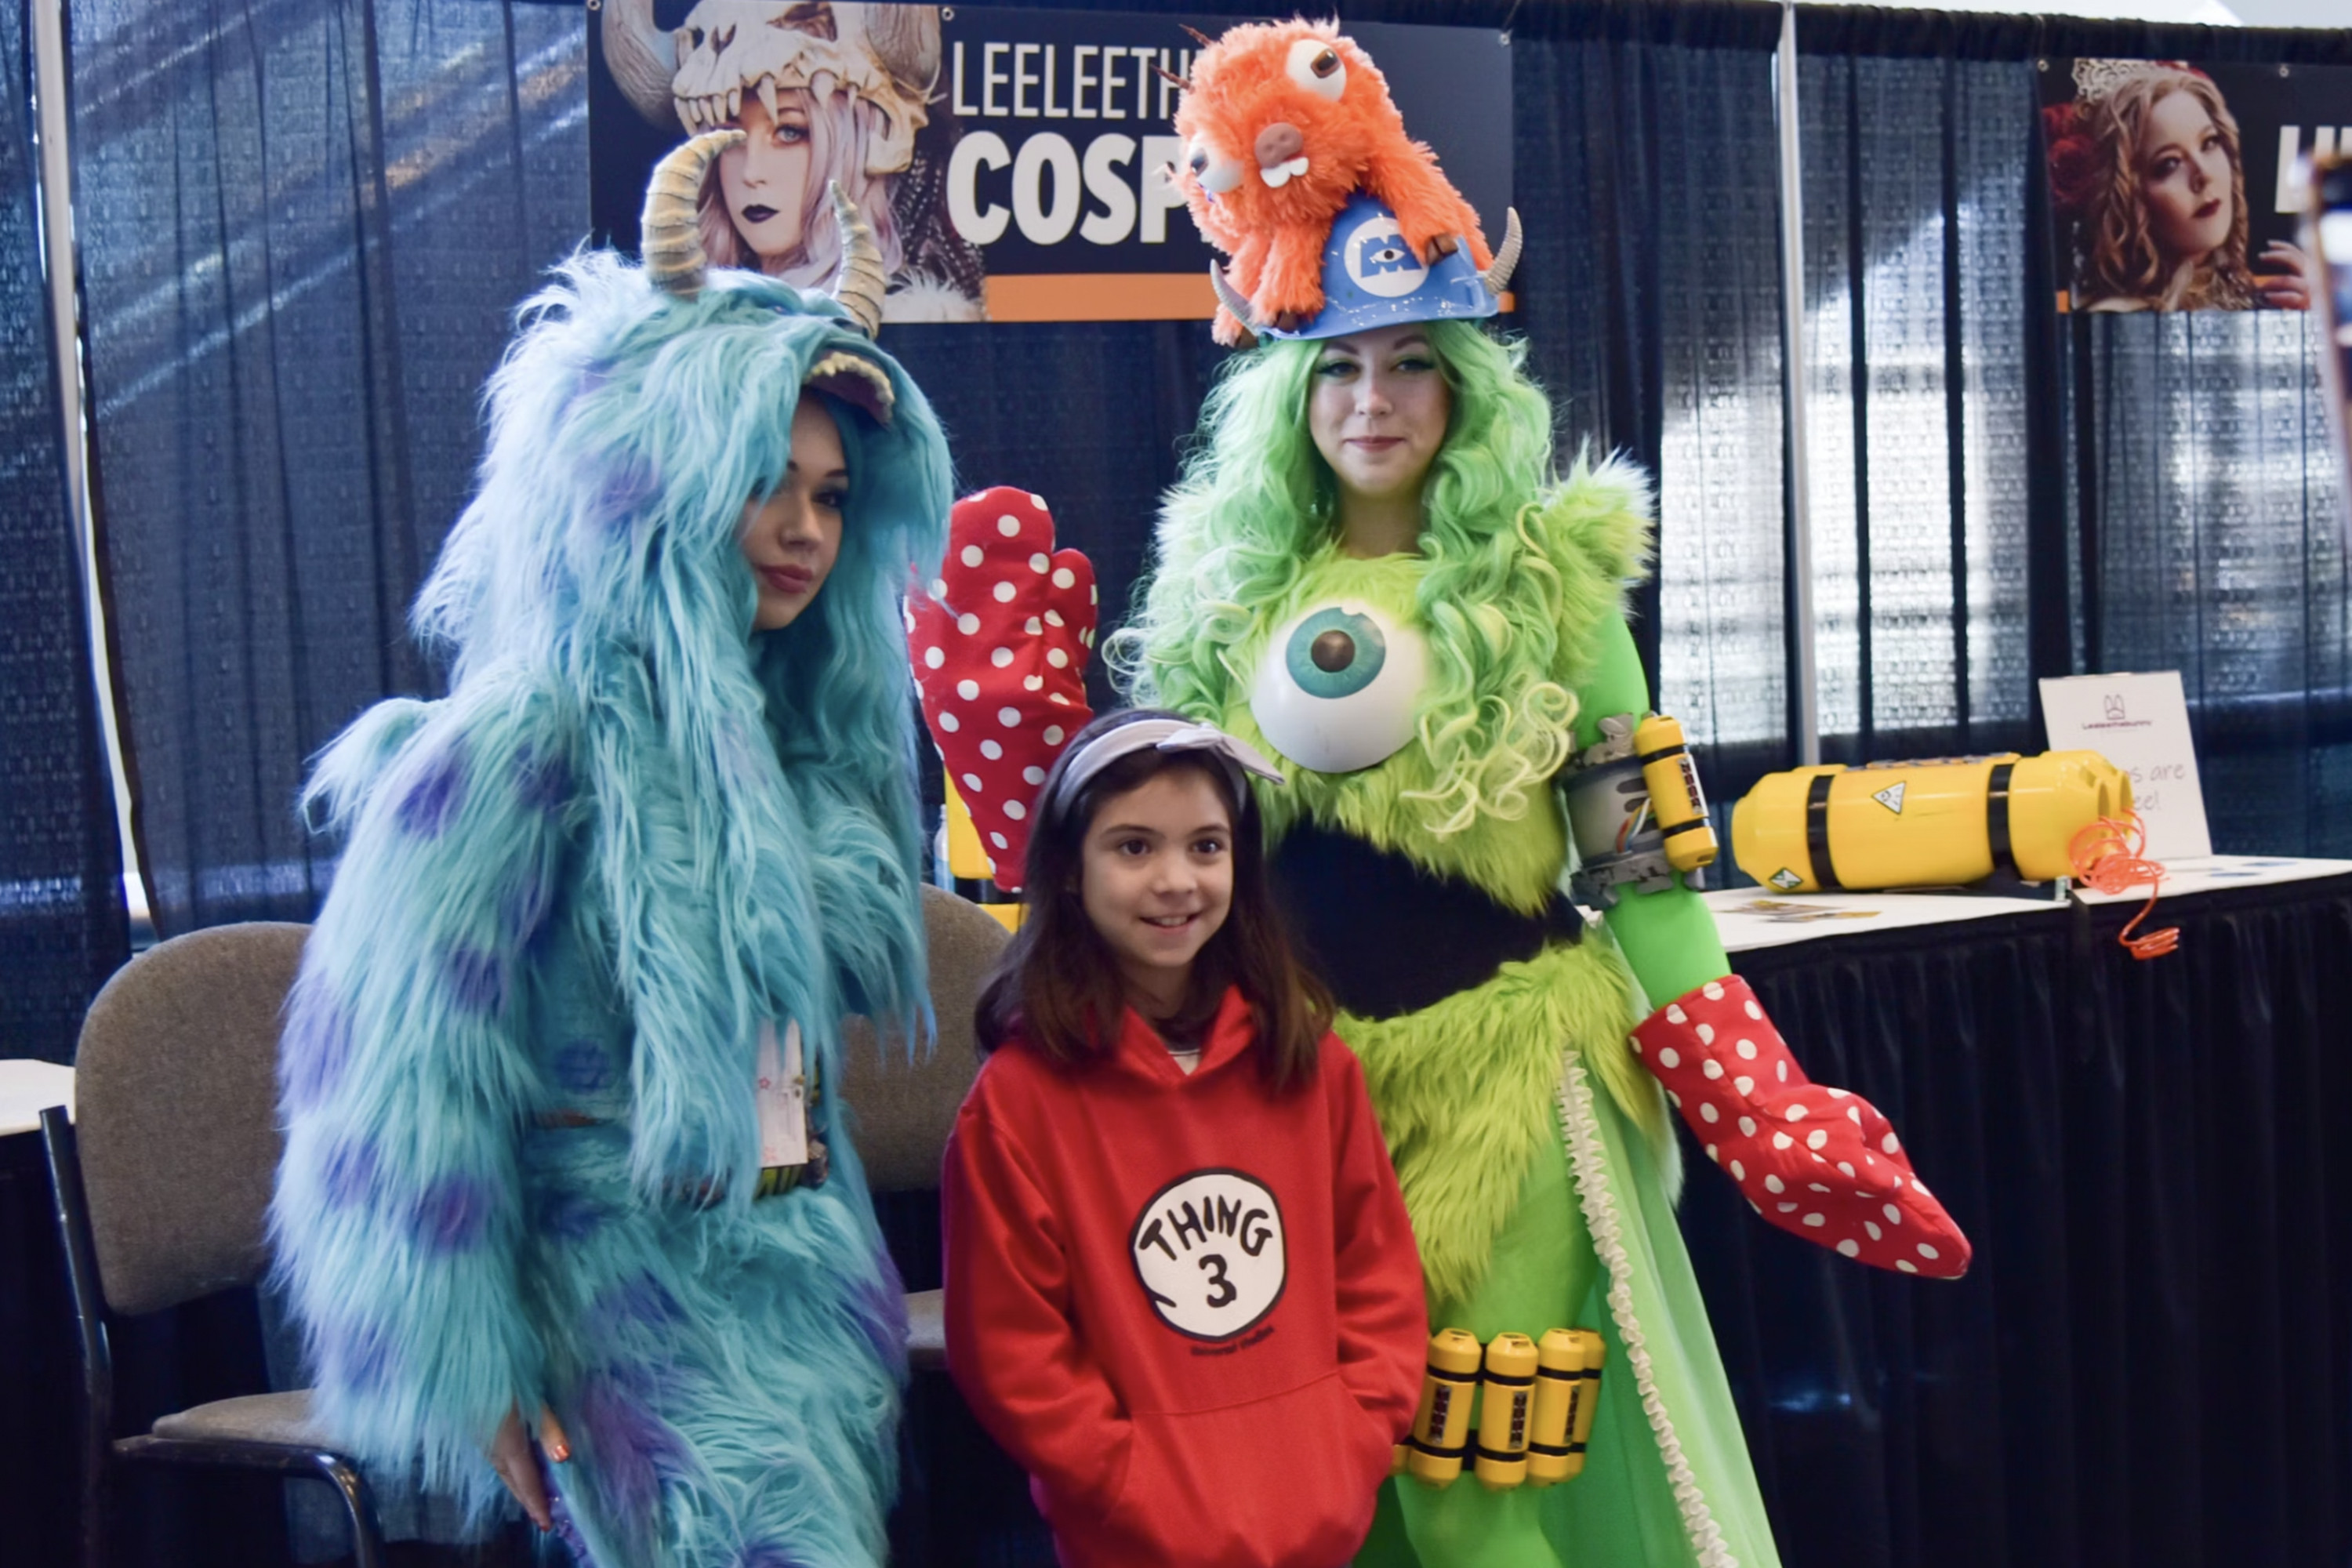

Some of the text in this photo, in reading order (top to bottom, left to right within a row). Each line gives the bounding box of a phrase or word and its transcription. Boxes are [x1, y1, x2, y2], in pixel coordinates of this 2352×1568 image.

[953, 41, 1205, 119] LEELEETH
[946, 130, 1213, 245] COSP
[2151, 764, 2186, 781] are
[1138, 1194, 1273, 1261] THING
[1199, 1254, 1236, 1308] 3
